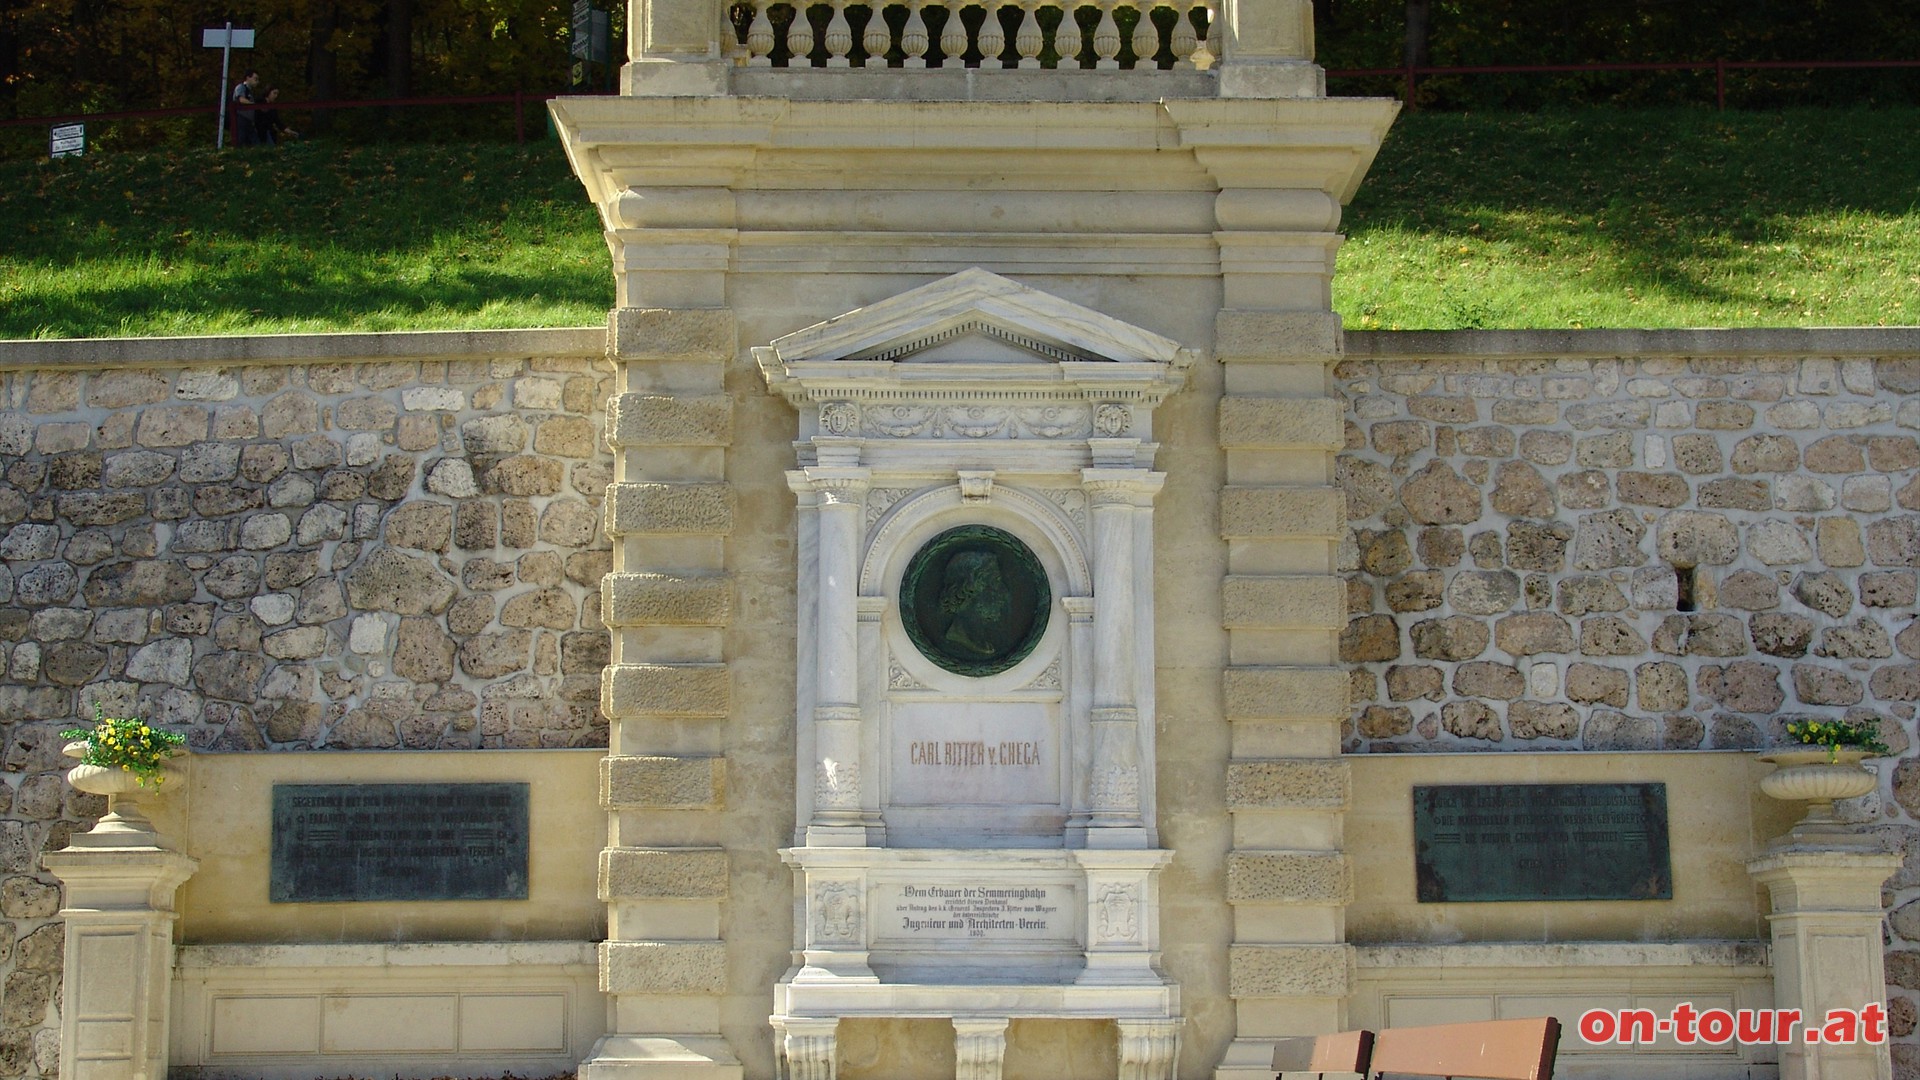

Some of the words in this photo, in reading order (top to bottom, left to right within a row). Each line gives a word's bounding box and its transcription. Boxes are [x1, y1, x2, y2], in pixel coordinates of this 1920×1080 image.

[910, 741, 942, 766] CARL
[945, 741, 984, 766] RITTER
[1000, 741, 1041, 766] GHEGA
[903, 885, 927, 898] Dem
[927, 886, 962, 898] Erbauer
[963, 888, 977, 898] der
[977, 886, 1046, 900] Semmeringbahn
[902, 917, 945, 931] Ingenieur
[948, 919, 963, 928] und
